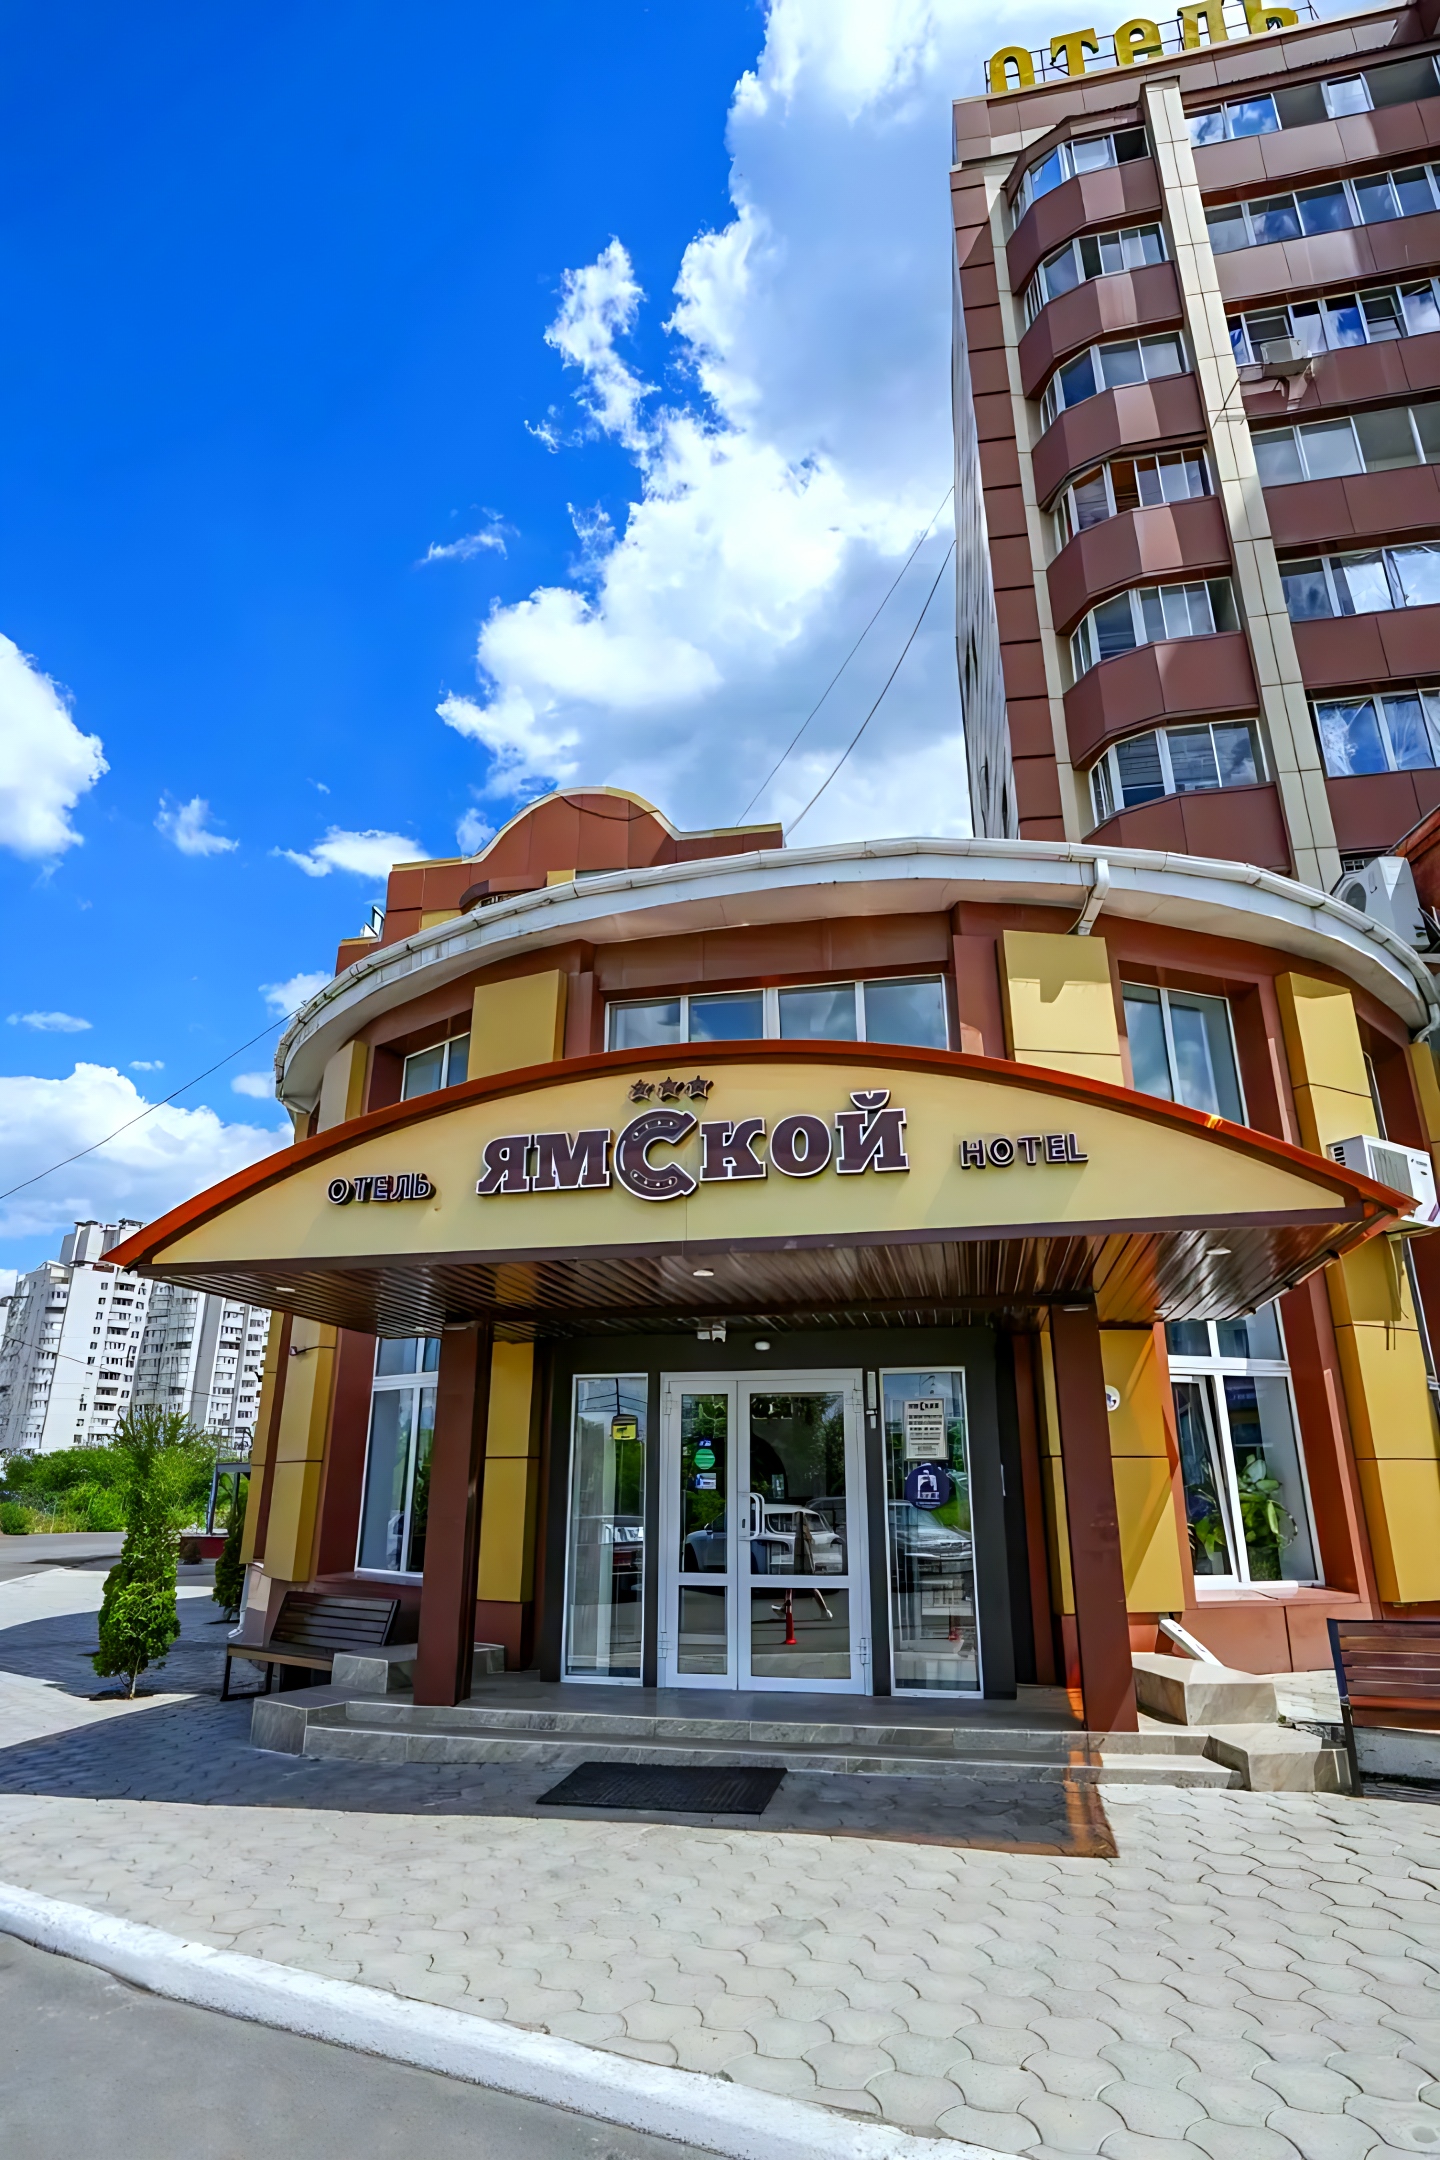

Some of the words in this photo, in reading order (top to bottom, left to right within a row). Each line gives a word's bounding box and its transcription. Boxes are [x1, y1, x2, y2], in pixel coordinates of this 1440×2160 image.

[476, 1089, 910, 1200] ЯМСКОЙ
[960, 1132, 1089, 1169] HOTEL
[328, 1173, 435, 1205] ОТЕЛЬ
